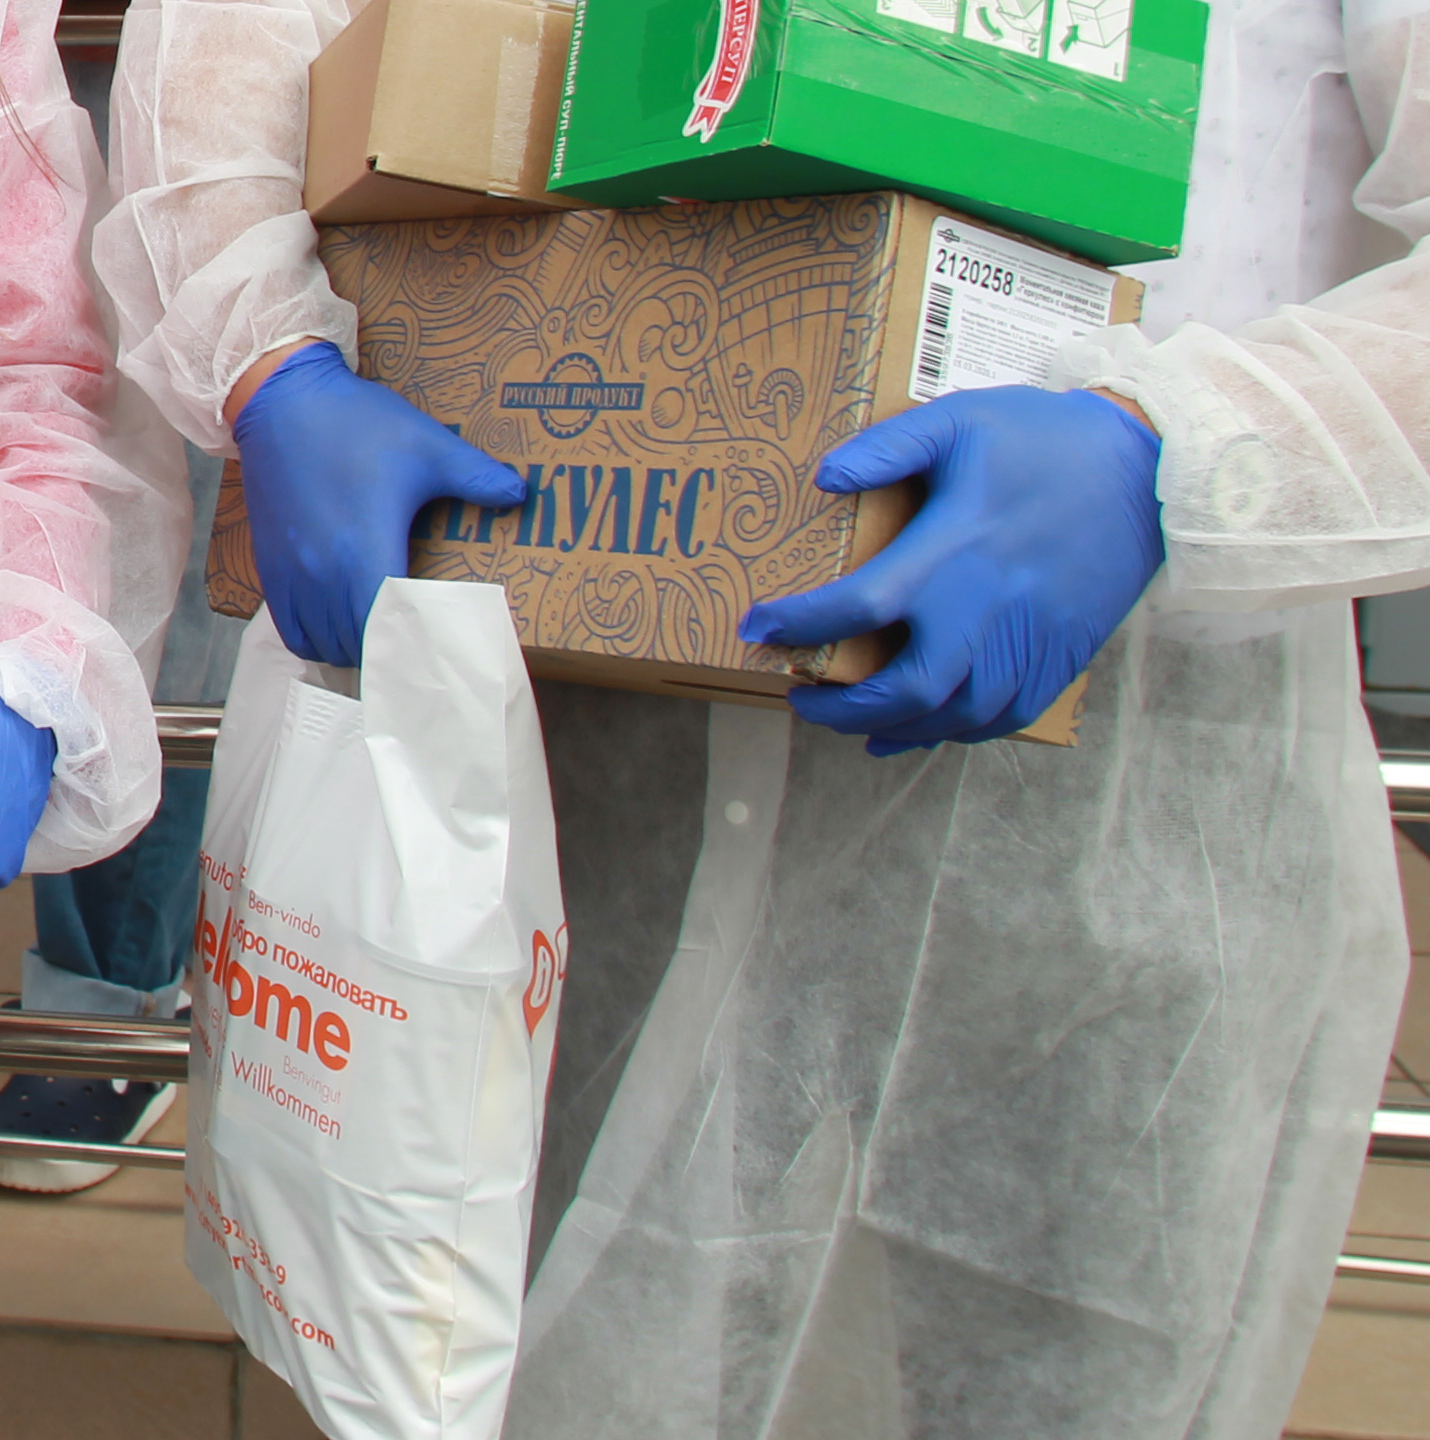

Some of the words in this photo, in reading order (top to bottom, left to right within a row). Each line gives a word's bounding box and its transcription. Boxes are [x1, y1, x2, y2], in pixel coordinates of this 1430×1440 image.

[934, 247, 1015, 297] 2120258
[501, 384, 568, 407] РУССКИЙ
[570, 386, 641, 408] ПРОДУКТ
[248, 888, 321, 939] Ben-vindo
[272, 942, 409, 1022] пожаловать
[231, 1050, 342, 1140] Willkommen
